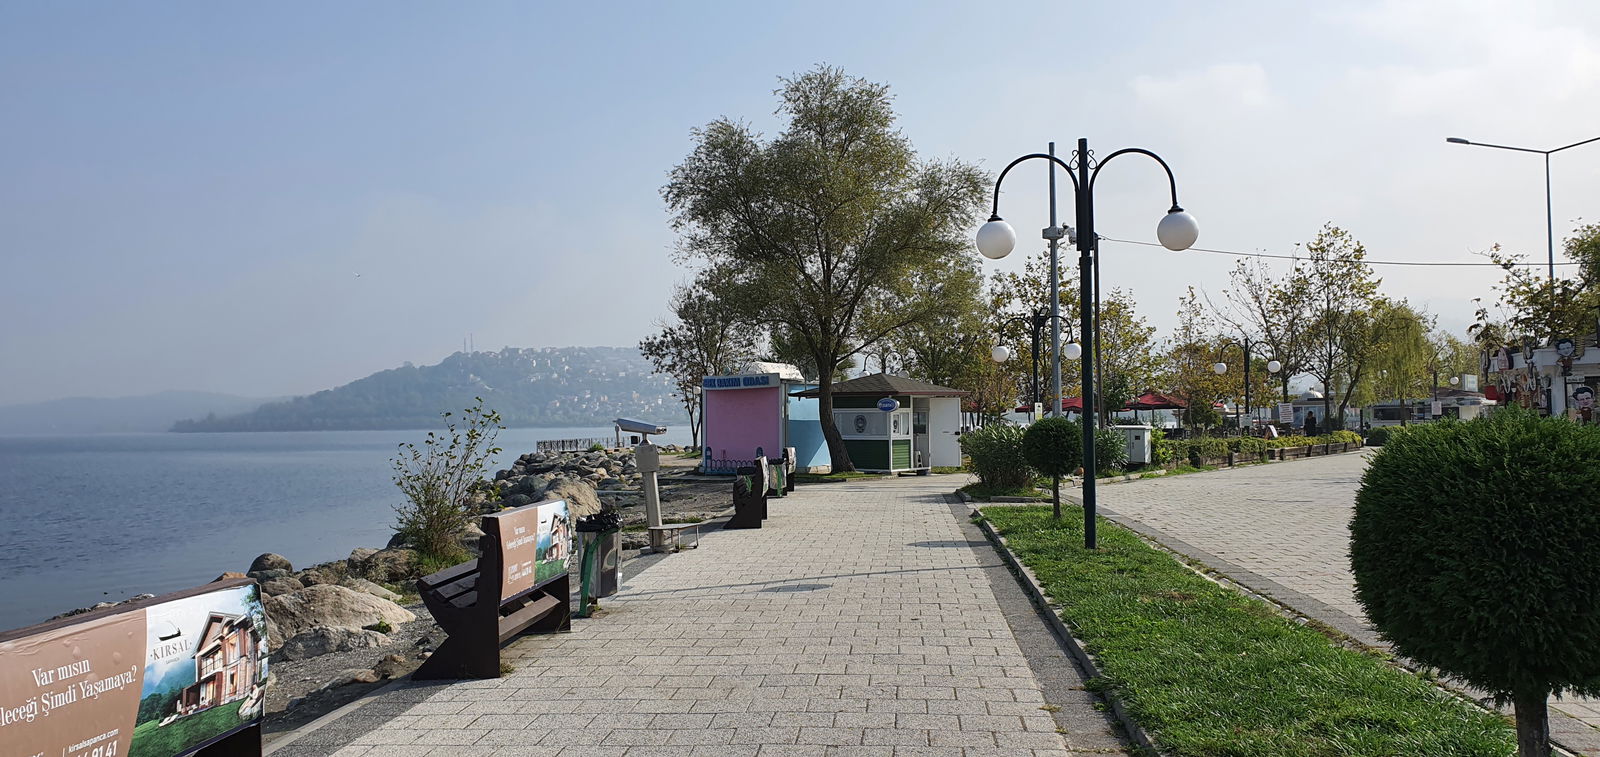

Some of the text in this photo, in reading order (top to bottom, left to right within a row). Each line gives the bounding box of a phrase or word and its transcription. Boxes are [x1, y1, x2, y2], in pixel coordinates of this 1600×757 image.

[153, 639, 191, 660] KIRSAL
[32, 660, 91, 687] Var mısın
[0, 665, 137, 726] leceği Şimdi Yaşamaya?
[68, 728, 119, 753] kirsalsapanca.com
